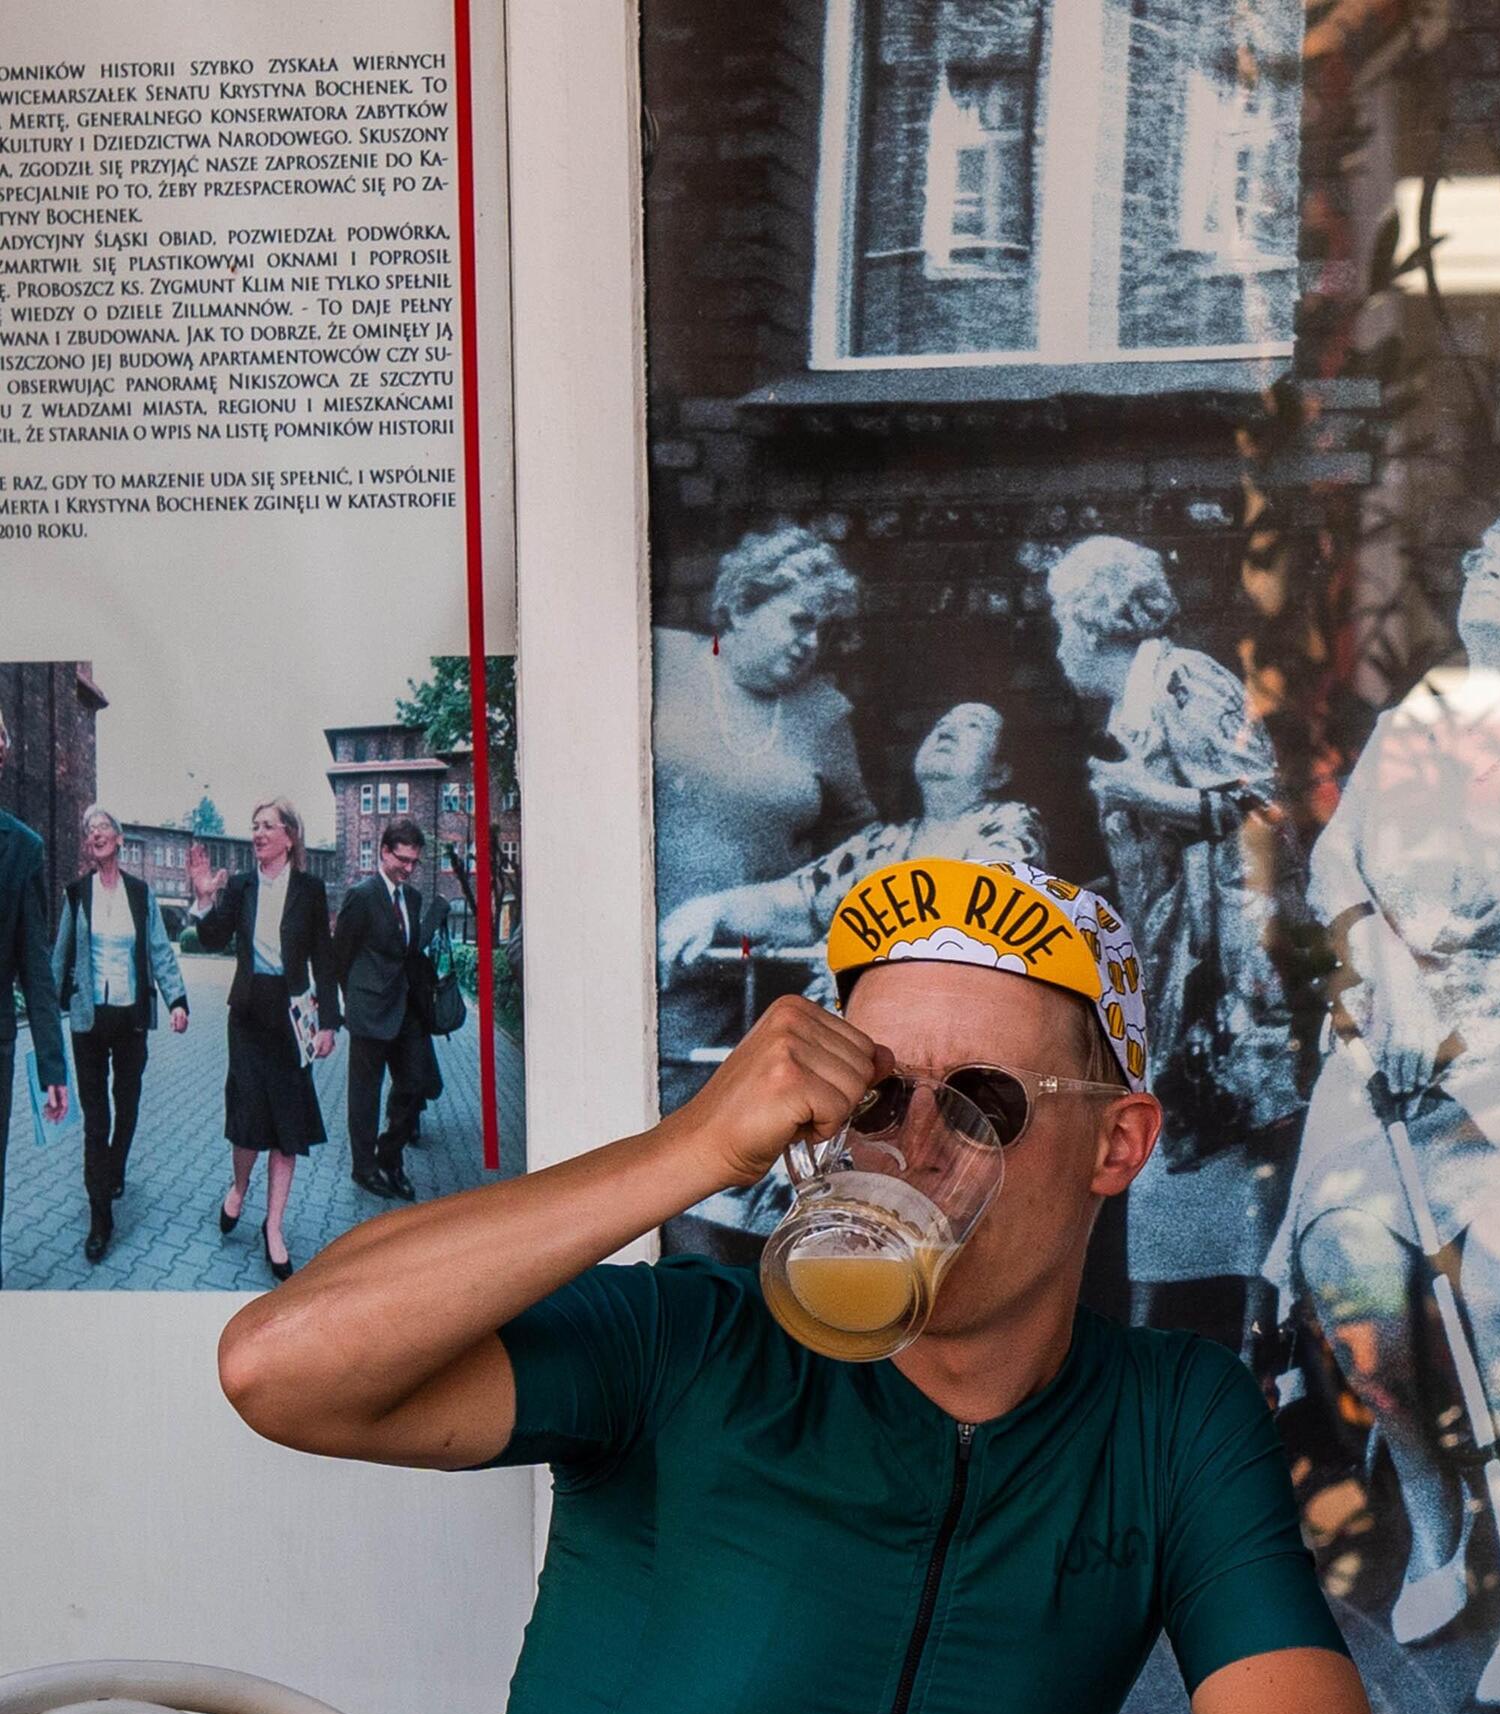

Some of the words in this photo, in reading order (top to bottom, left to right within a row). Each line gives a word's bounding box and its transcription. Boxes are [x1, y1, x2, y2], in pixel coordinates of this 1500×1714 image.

[101, 62, 174, 78] HISTORII
[190, 59, 254, 76] SZYBKO
[268, 57, 339, 74] ZYSKAŁA
[352, 55, 446, 71] WIERNYCH
[0, 86, 138, 106] WICEMARSZAŁEK
[146, 84, 210, 102] SENATU
[220, 82, 306, 100] KRYSTYNA
[421, 76, 448, 94] TO
[77, 108, 202, 128] GENERALNEGO
[210, 106, 348, 124] KONSERWATORA
[355, 99, 448, 120] ZABYTKÓW
[80, 137, 84, 152] I
[94, 133, 212, 152] DZIEDZICTWA
[359, 126, 449, 144] SKUSZONY
[19, 160, 94, 178] ZGODZIŁ
[100, 160, 123, 179] SIĘ
[130, 154, 199, 178] PRZYJĄĆ
[206, 156, 258, 172] NASZE
[265, 153, 378, 171] ZAPROSZENIE
[386, 152, 412, 168] DO
[96, 184, 119, 200] PO
[158, 180, 198, 198] ŻEBY
[204, 174, 356, 197] PRZESPACEROWAĆ
[362, 177, 386, 197] SIĘ
[393, 176, 416, 192] PO
[0, 233, 85, 253] ADYCYJNY
[94, 230, 148, 252] ŚLĄSKI
[228, 227, 336, 245] POZWIEDZAŁ
[93, 256, 116, 276] SIĘ
[129, 253, 254, 270] PLASTIKOWYMI
[266, 251, 338, 268] OKNAMI
[351, 251, 356, 266] I
[370, 248, 452, 266] POPROSIŁ
[17, 281, 115, 298] PROBOSZCZ
[150, 278, 236, 295] ZYGMUNT
[242, 275, 285, 293] KLIM
[291, 276, 320, 292] NIE
[324, 274, 380, 291] TYLKO
[386, 273, 452, 290] SPEŁNIŁ
[10, 306, 75, 322] WIEDZY
[83, 305, 98, 321] O
[107, 304, 163, 320] DZIELE
[316, 298, 342, 316] TO
[352, 299, 391, 318] DAJE
[401, 297, 453, 314] PEŁNY
[0, 331, 50, 346] WANA
[56, 331, 60, 346] I
[186, 325, 216, 345] JAK
[220, 326, 244, 342] TO
[327, 321, 347, 340] ŻE
[352, 322, 430, 342] OMINĘŁY
[435, 322, 454, 342] JĄ
[92, 353, 112, 372] JEJ
[120, 352, 194, 371] BUDOWĄ
[199, 345, 381, 367] APARTAMENTOWCÓW
[386, 346, 420, 363] CZY
[7, 378, 115, 398] OBSERWUJĄC
[126, 376, 218, 395] PANORAMĘ
[229, 372, 340, 390] NIKISZOWCA
[349, 372, 370, 388] ZE
[380, 370, 454, 388] SZCZYTU
[22, 404, 32, 418] Z
[41, 401, 132, 418] WŁADZAMI
[218, 398, 296, 414] REGIONU
[308, 398, 312, 412] I
[324, 392, 454, 412] MIESZKAŃCAMI
[26, 424, 44, 443] ŻE
[49, 426, 129, 442] STARANIA
[133, 425, 147, 441] O
[150, 424, 192, 440] WPIS
[197, 424, 221, 439] NA
[226, 423, 269, 442] LISTĘ
[274, 417, 374, 438] POMNIKÓW
[379, 419, 454, 436] HISTORII
[52, 474, 88, 490] GDY
[92, 474, 116, 489] TO
[121, 472, 205, 489] MARZENIE
[210, 472, 247, 488] UDA
[251, 471, 275, 491] SIĘ
[358, 470, 364, 484] I
[369, 465, 454, 484] WSPÓLNIE
[54, 499, 59, 514] I
[66, 496, 150, 514] KRYSTYNA
[156, 495, 249, 512] BOCHENEK
[254, 494, 320, 514] ZGINĘLI
[326, 494, 342, 509] W
[348, 492, 454, 509] KATASTROFIE
[839, 869, 942, 952] BEER
[964, 875, 1073, 965] RIDE
